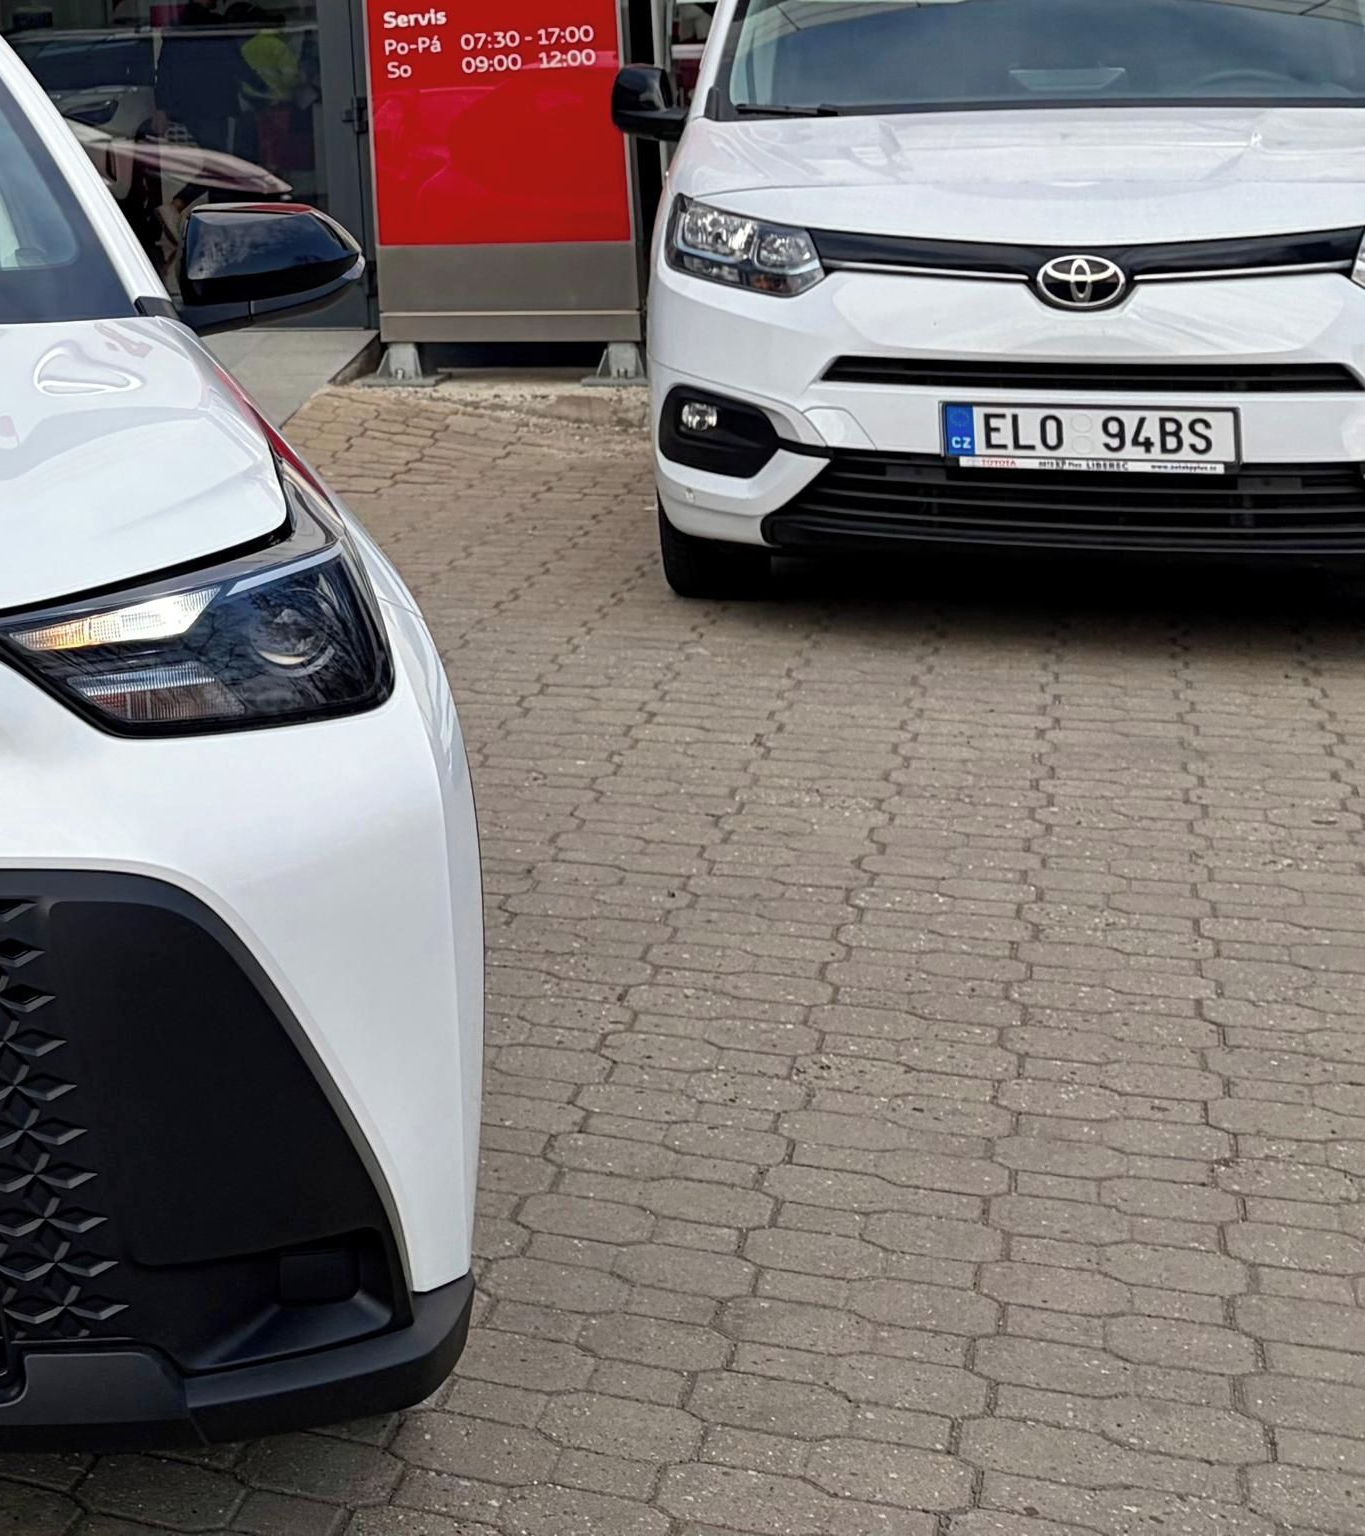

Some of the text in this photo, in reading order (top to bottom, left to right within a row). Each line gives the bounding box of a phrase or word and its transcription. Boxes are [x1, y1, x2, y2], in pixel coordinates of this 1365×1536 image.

[382, 9, 447, 29] Servis
[384, 35, 442, 56] Po-Pá
[460, 29, 520, 51] 07:30
[537, 25, 594, 46] 17:00
[386, 48, 596, 79] So 09:00 12:00
[951, 437, 972, 449] CZ
[1101, 415, 1213, 455] 94BS
